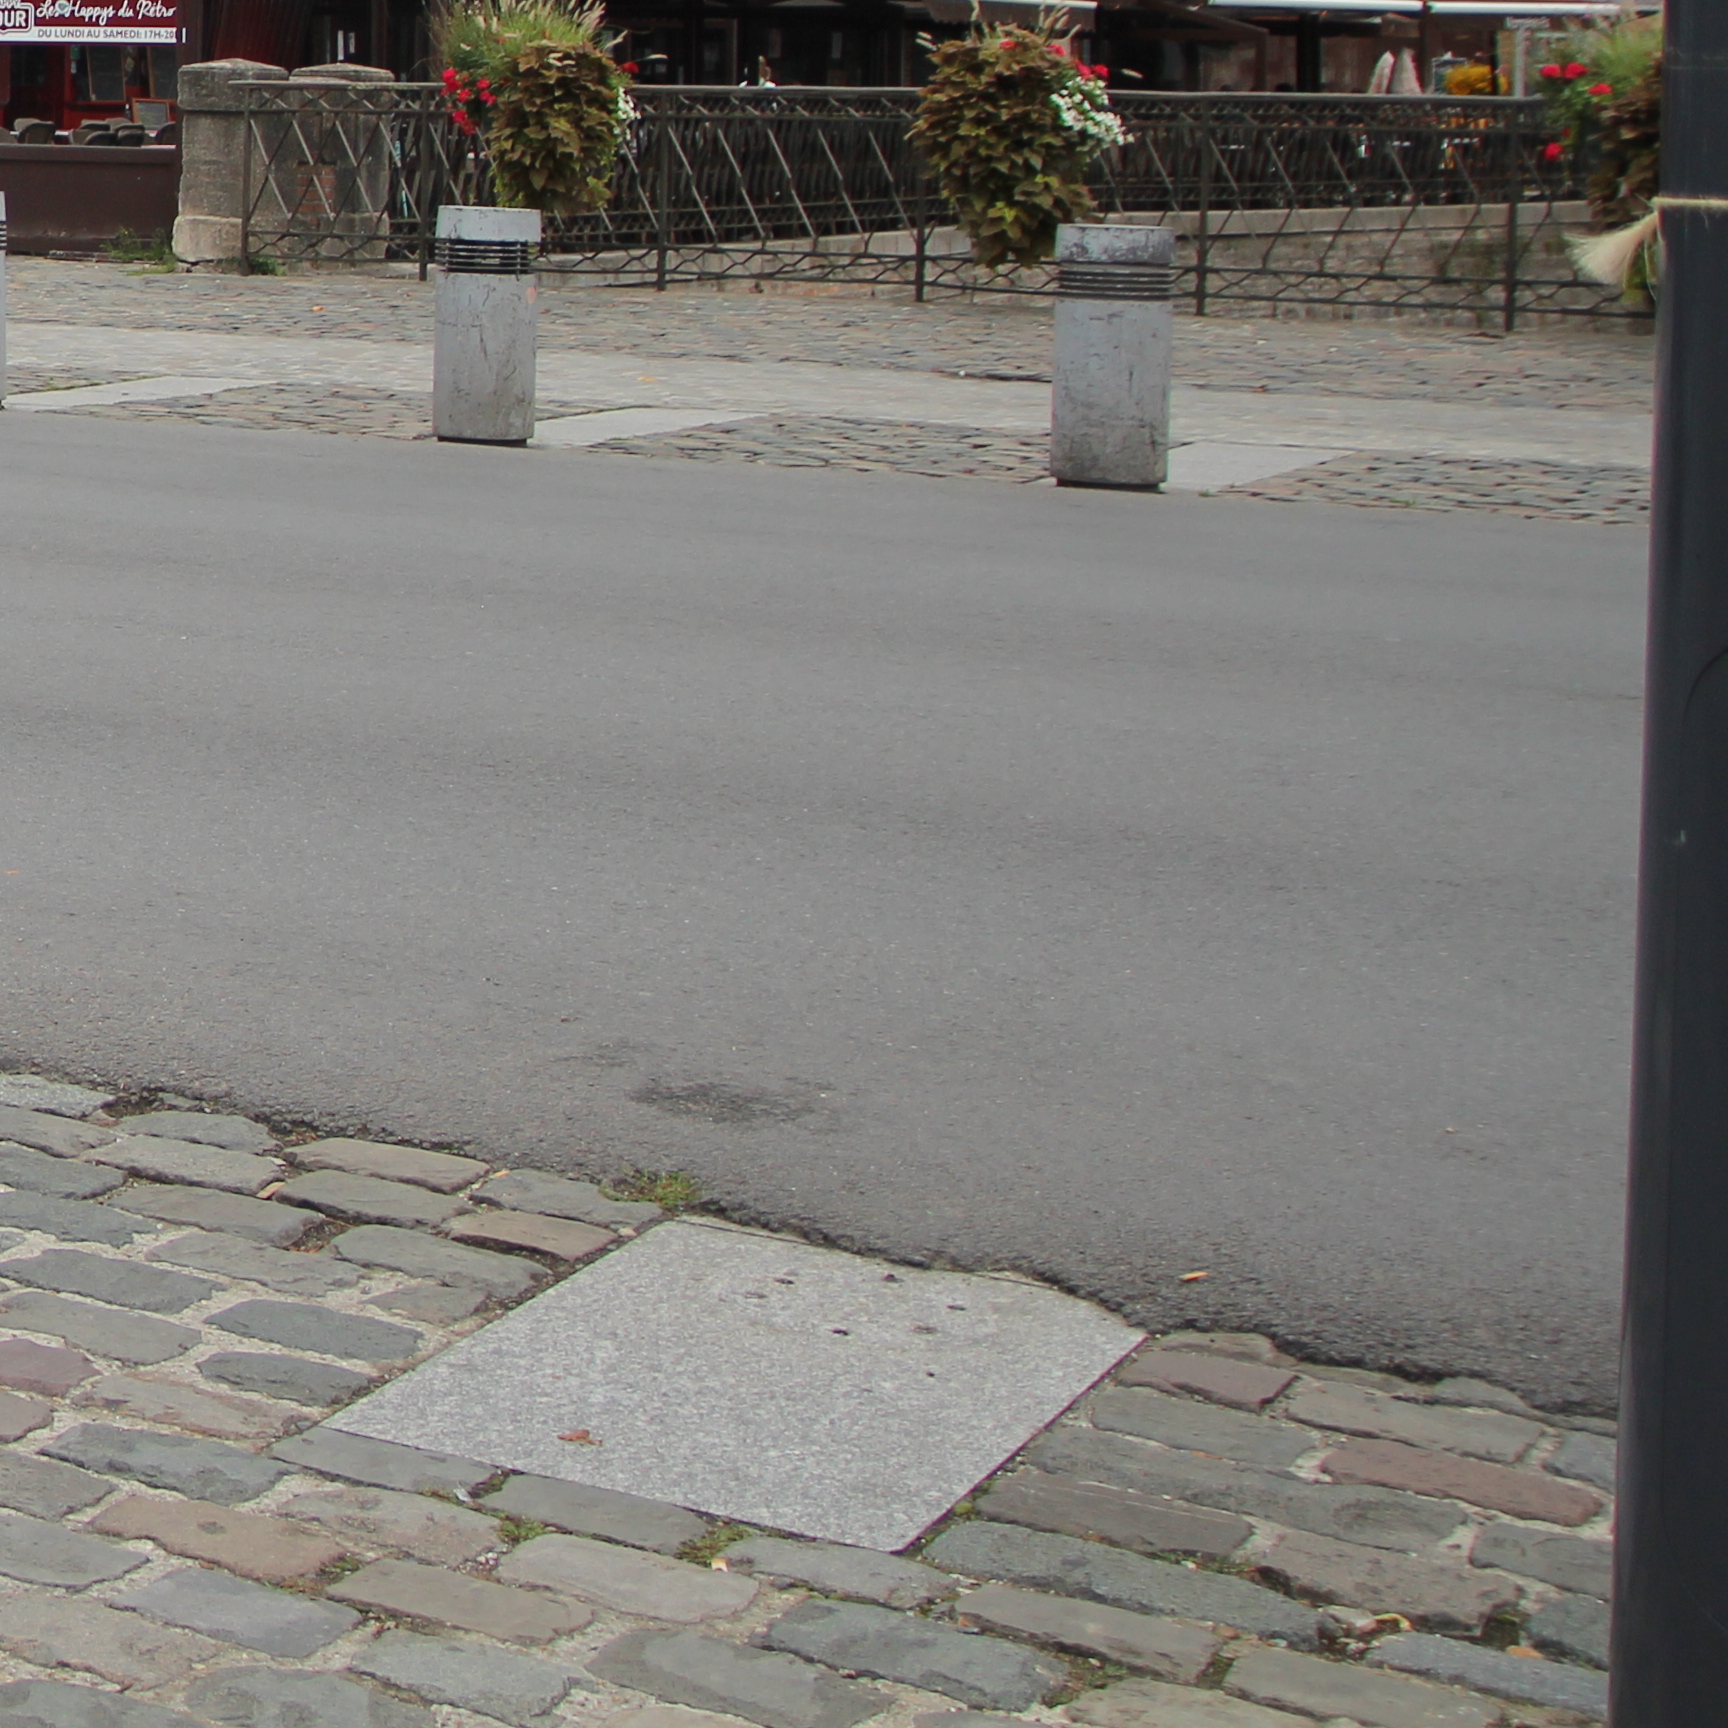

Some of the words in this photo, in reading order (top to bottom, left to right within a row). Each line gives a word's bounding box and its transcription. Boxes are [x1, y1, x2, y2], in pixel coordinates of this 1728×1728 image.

[117, 0, 134, 18] du
[37, 29, 52, 38] DU
[54, 29, 85, 38] LUNDI
[87, 29, 101, 38] AU
